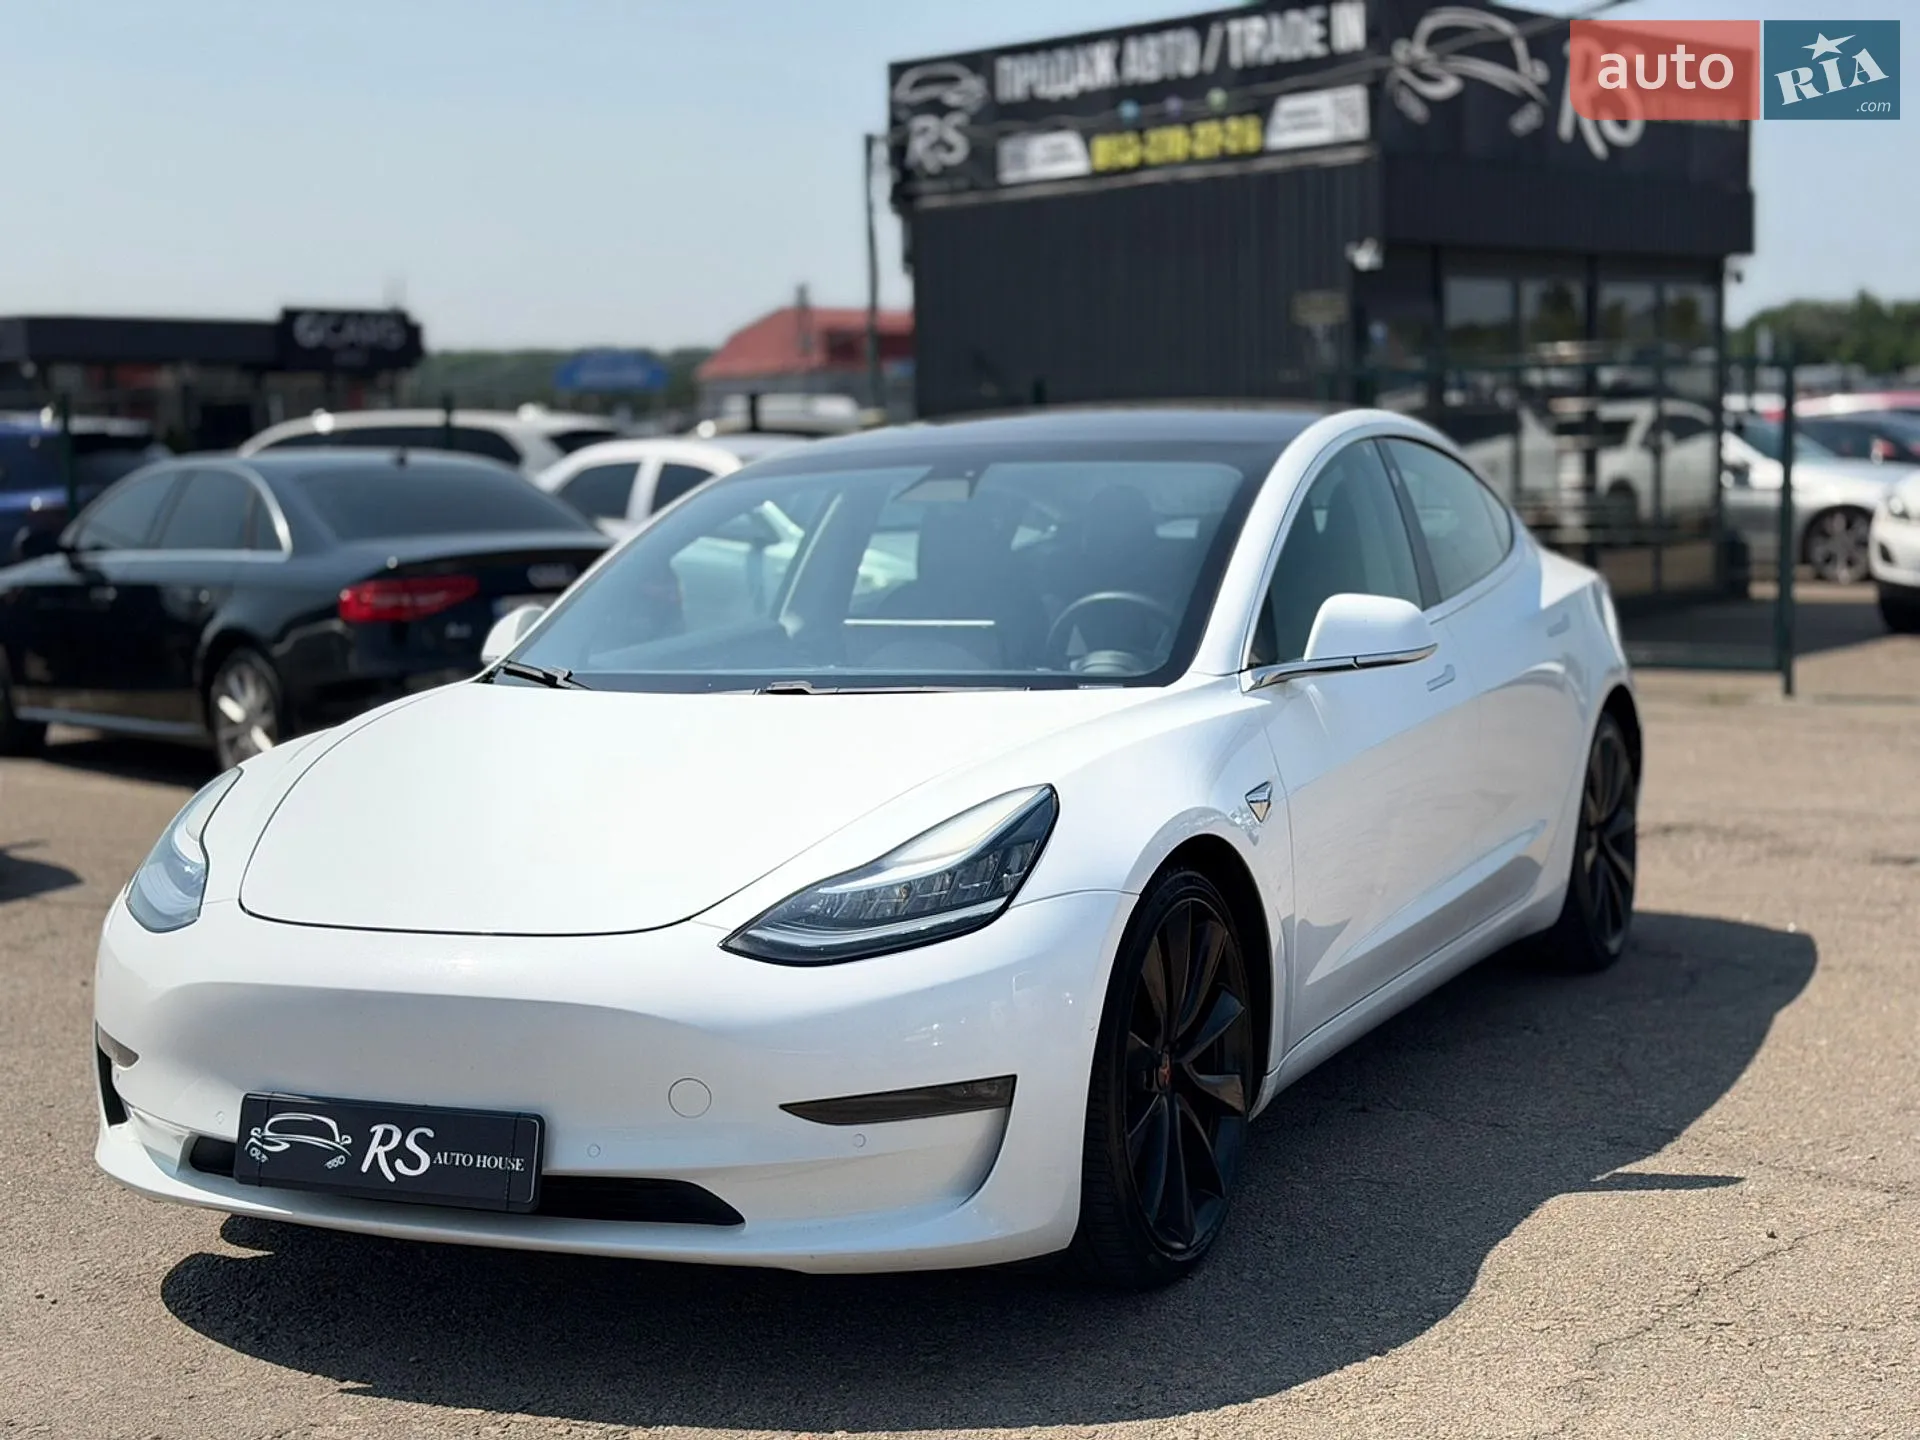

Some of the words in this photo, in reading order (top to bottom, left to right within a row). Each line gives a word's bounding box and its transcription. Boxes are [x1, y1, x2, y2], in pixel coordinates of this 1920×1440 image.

[995, 39, 1119, 103] ПРОДАЖ
[1121, 27, 1200, 85] АВТО
[1227, 6, 1328, 69] TRADE
[1330, 2, 1366, 54] IN
[361, 1123, 435, 1182] RS
[433, 1152, 473, 1168] AUTO
[475, 1155, 525, 1171] HOUSE
